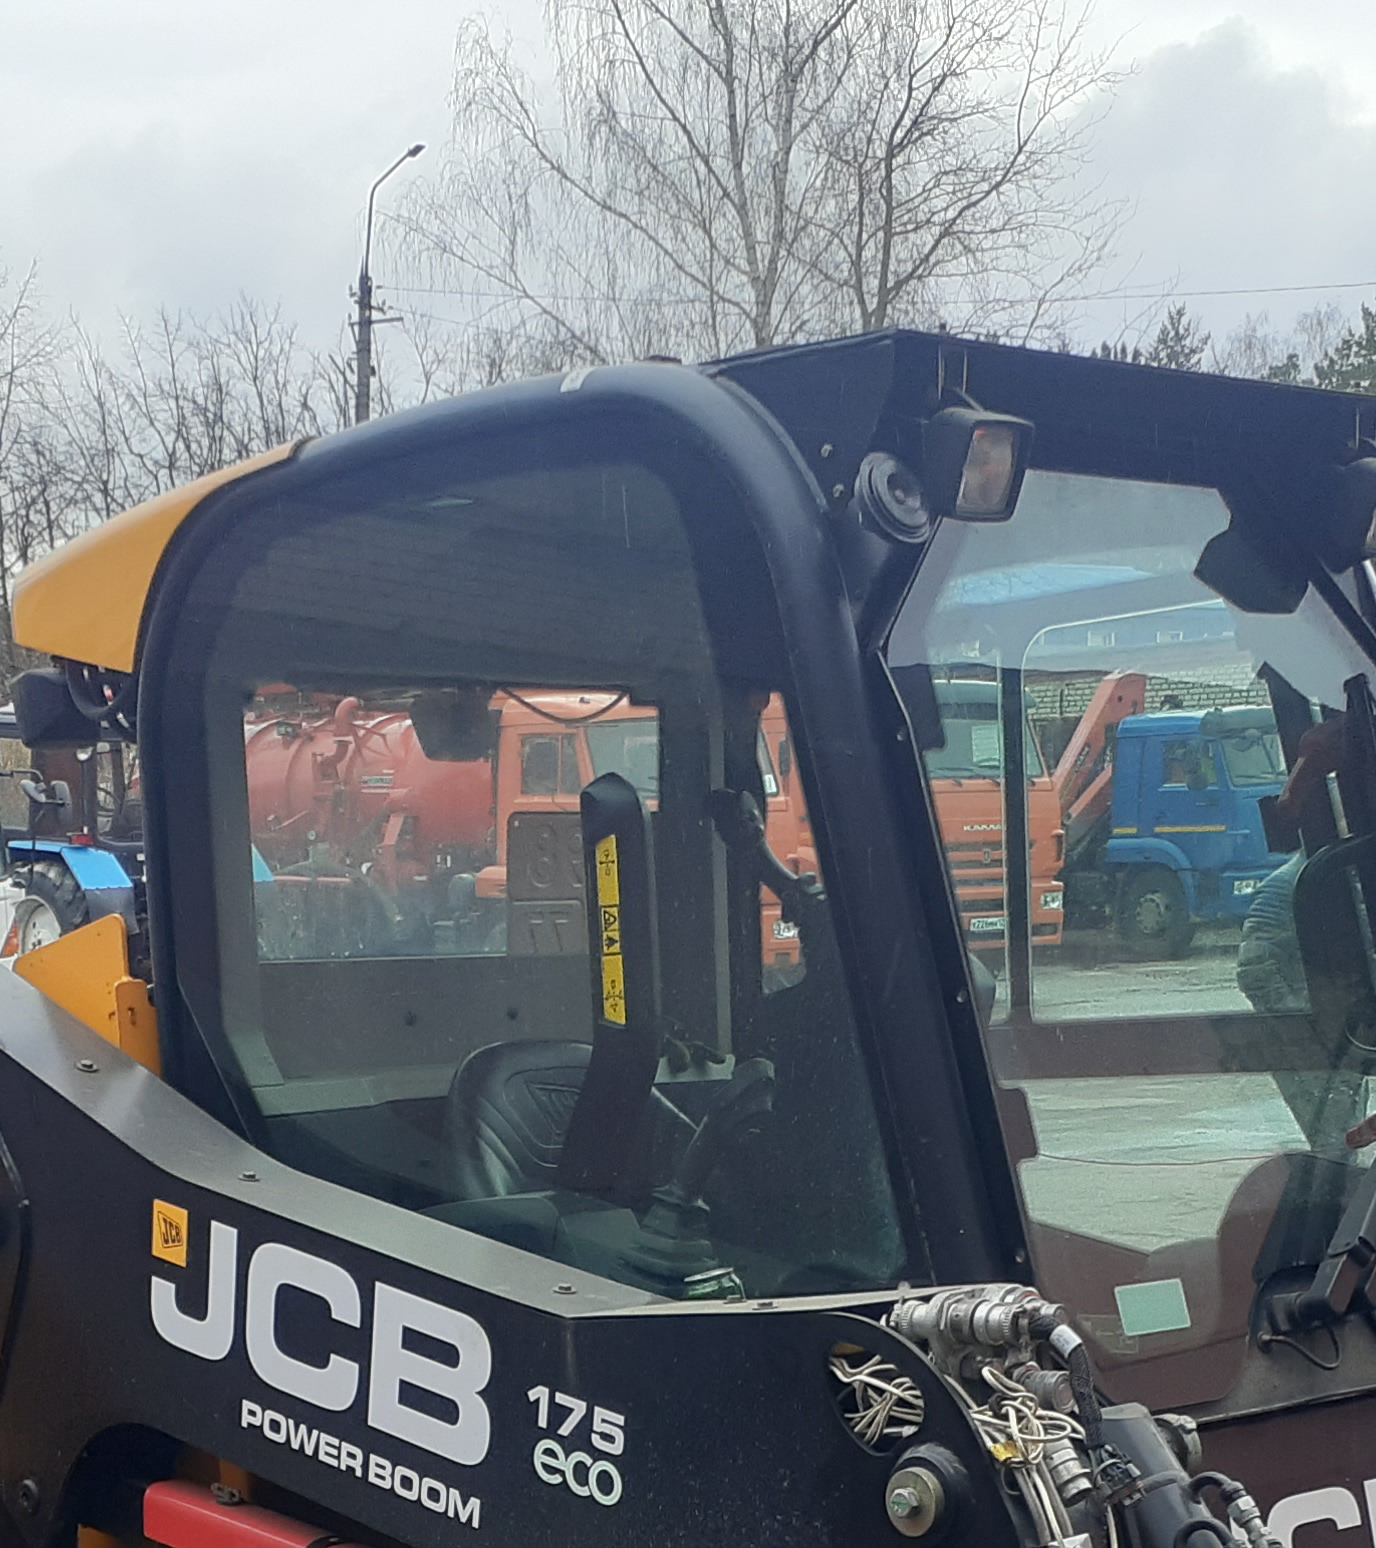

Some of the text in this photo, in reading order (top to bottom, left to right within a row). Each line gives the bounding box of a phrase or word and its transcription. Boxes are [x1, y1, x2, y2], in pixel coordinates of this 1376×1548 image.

[161, 1216, 182, 1245] JCB
[150, 1219, 492, 1466] JCB
[527, 1384, 625, 1456] 175
[241, 1398, 481, 1529] POWER BOOM
[533, 1438, 623, 1506] eco
